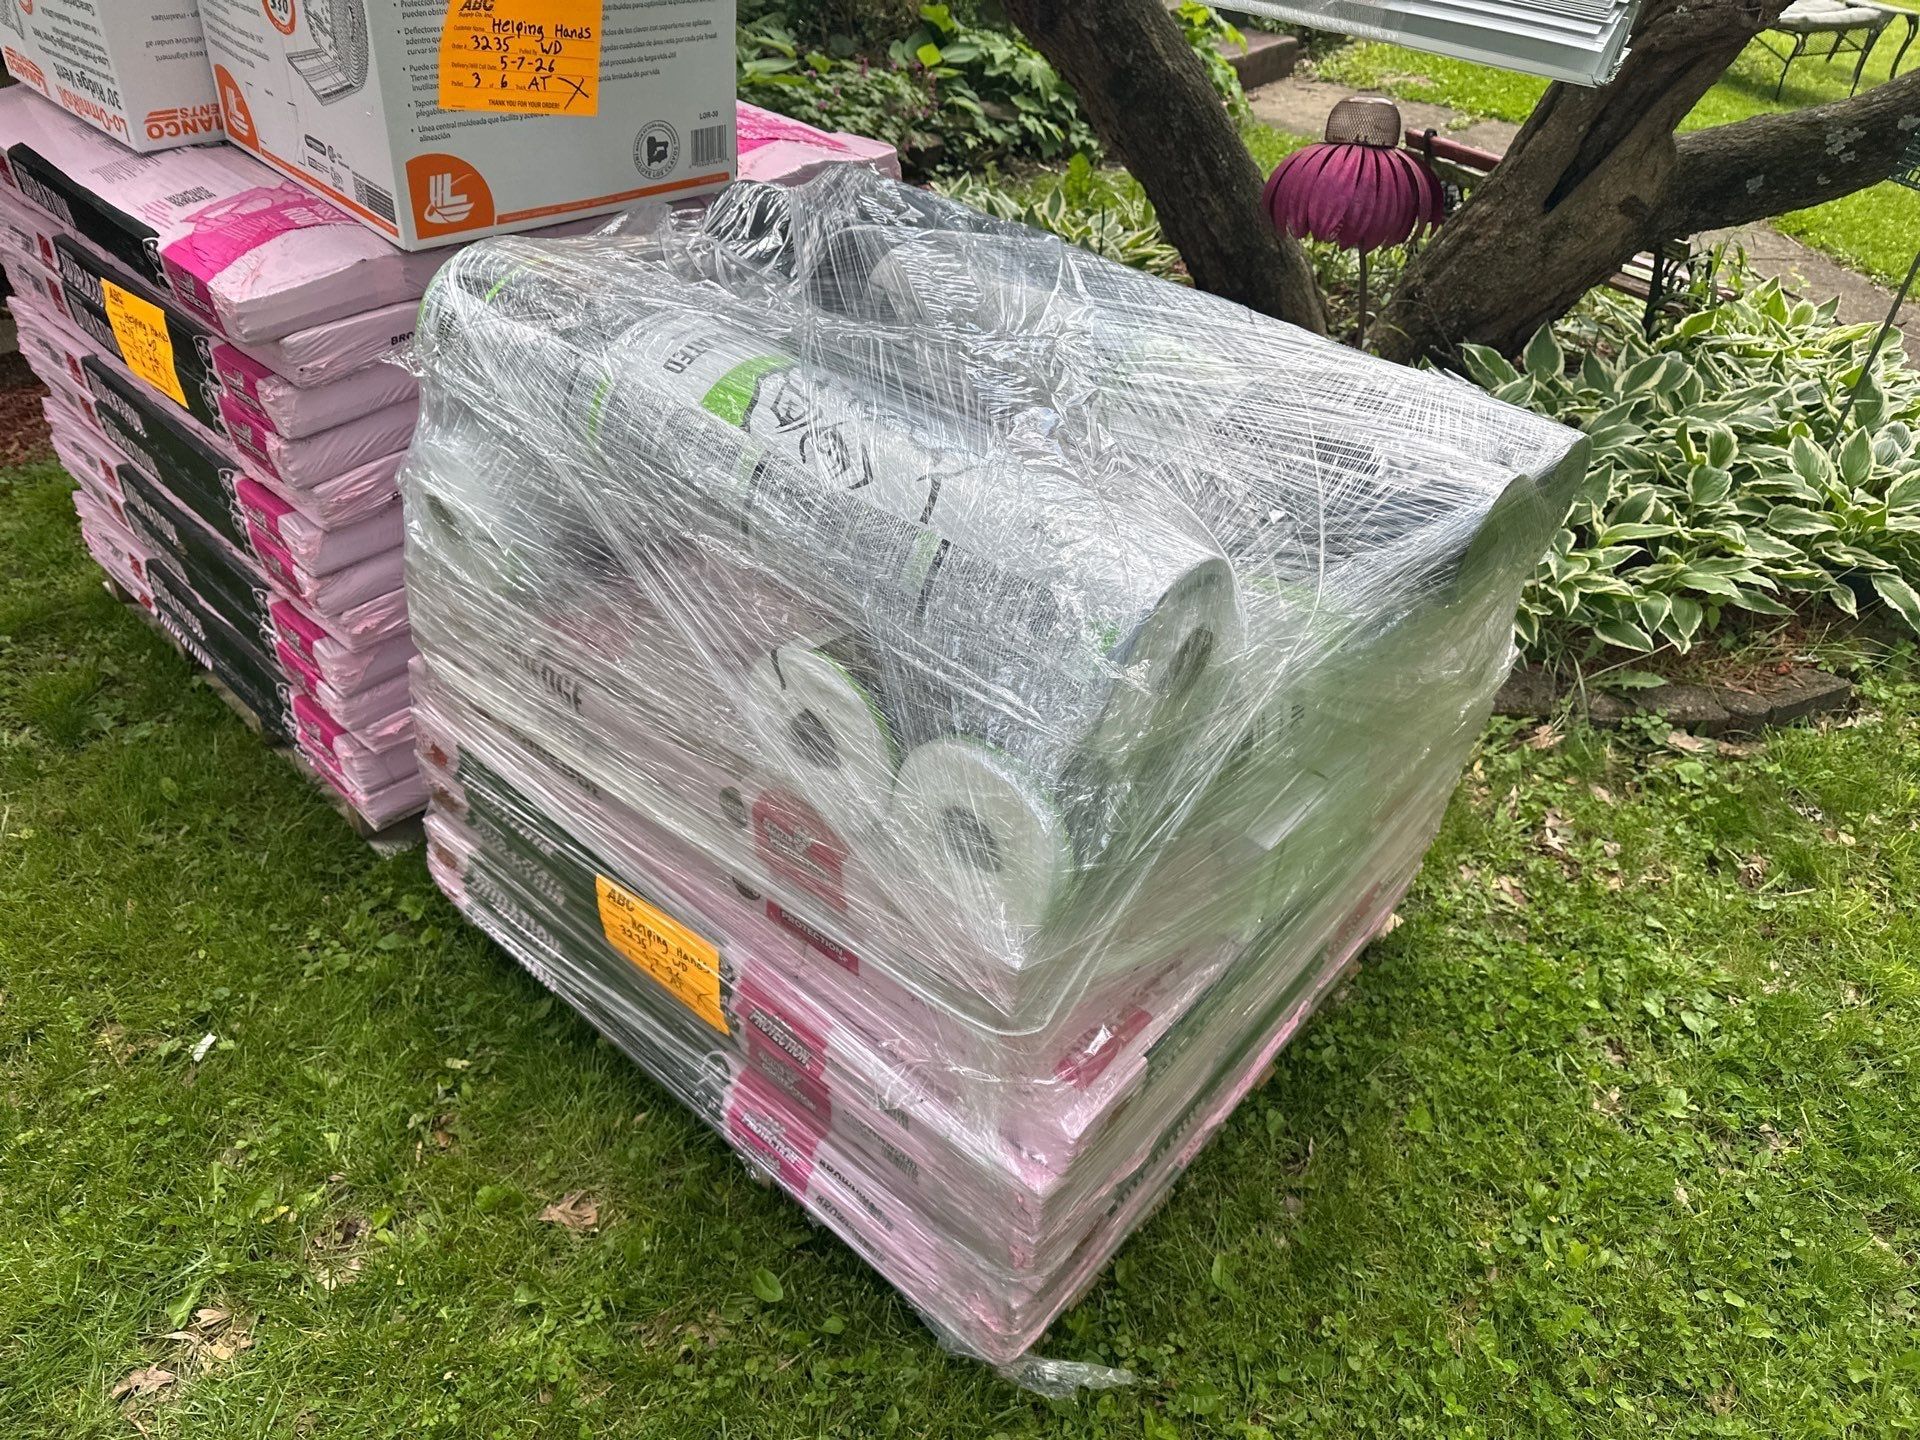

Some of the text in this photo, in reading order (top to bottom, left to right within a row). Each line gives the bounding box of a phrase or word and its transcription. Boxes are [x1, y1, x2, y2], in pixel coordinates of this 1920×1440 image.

[402, 10, 427, 19] pueden
[404, 26, 440, 35] Deflectores
[492, 18, 592, 42] Helping Hands
[471, 35, 516, 52] 3235
[541, 41, 562, 55] WD
[155, 51, 188, 62] alignment
[500, 55, 555, 72] 5-7-26
[409, 63, 429, 71] Puede
[53, 62, 78, 90] Vent
[472, 72, 481, 88] 3
[500, 74, 508, 88] 6
[527, 76, 552, 91] AT
[76, 70, 107, 104] Ridge
[178, 103, 220, 118] ENTS
[414, 99, 439, 108] Tapone
[436, 122, 457, 131] central
[457, 118, 487, 128] moldeada
[488, 117, 499, 126] que
[606, 888, 634, 912] ABC
[781, 908, 844, 957] PROTECTION
[750, 1008, 812, 1067] PROTECTION
